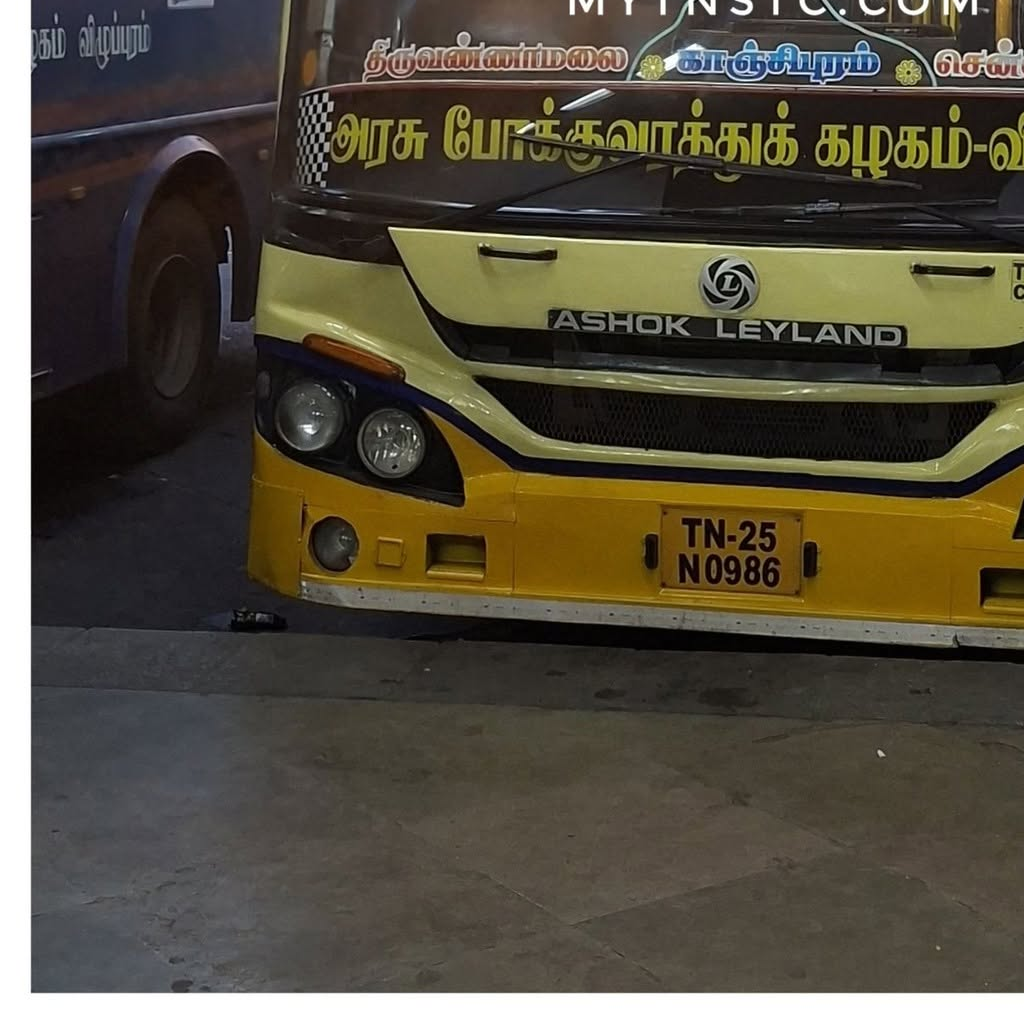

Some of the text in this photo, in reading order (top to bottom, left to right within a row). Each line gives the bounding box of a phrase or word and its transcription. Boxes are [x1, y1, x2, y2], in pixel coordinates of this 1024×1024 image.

[361, 31, 629, 83] திருவண்ணாமலை
[330, 113, 428, 169] அரசு
[553, 311, 902, 347] ASHOK LEYLAND
[681, 517, 777, 553] TN-25
